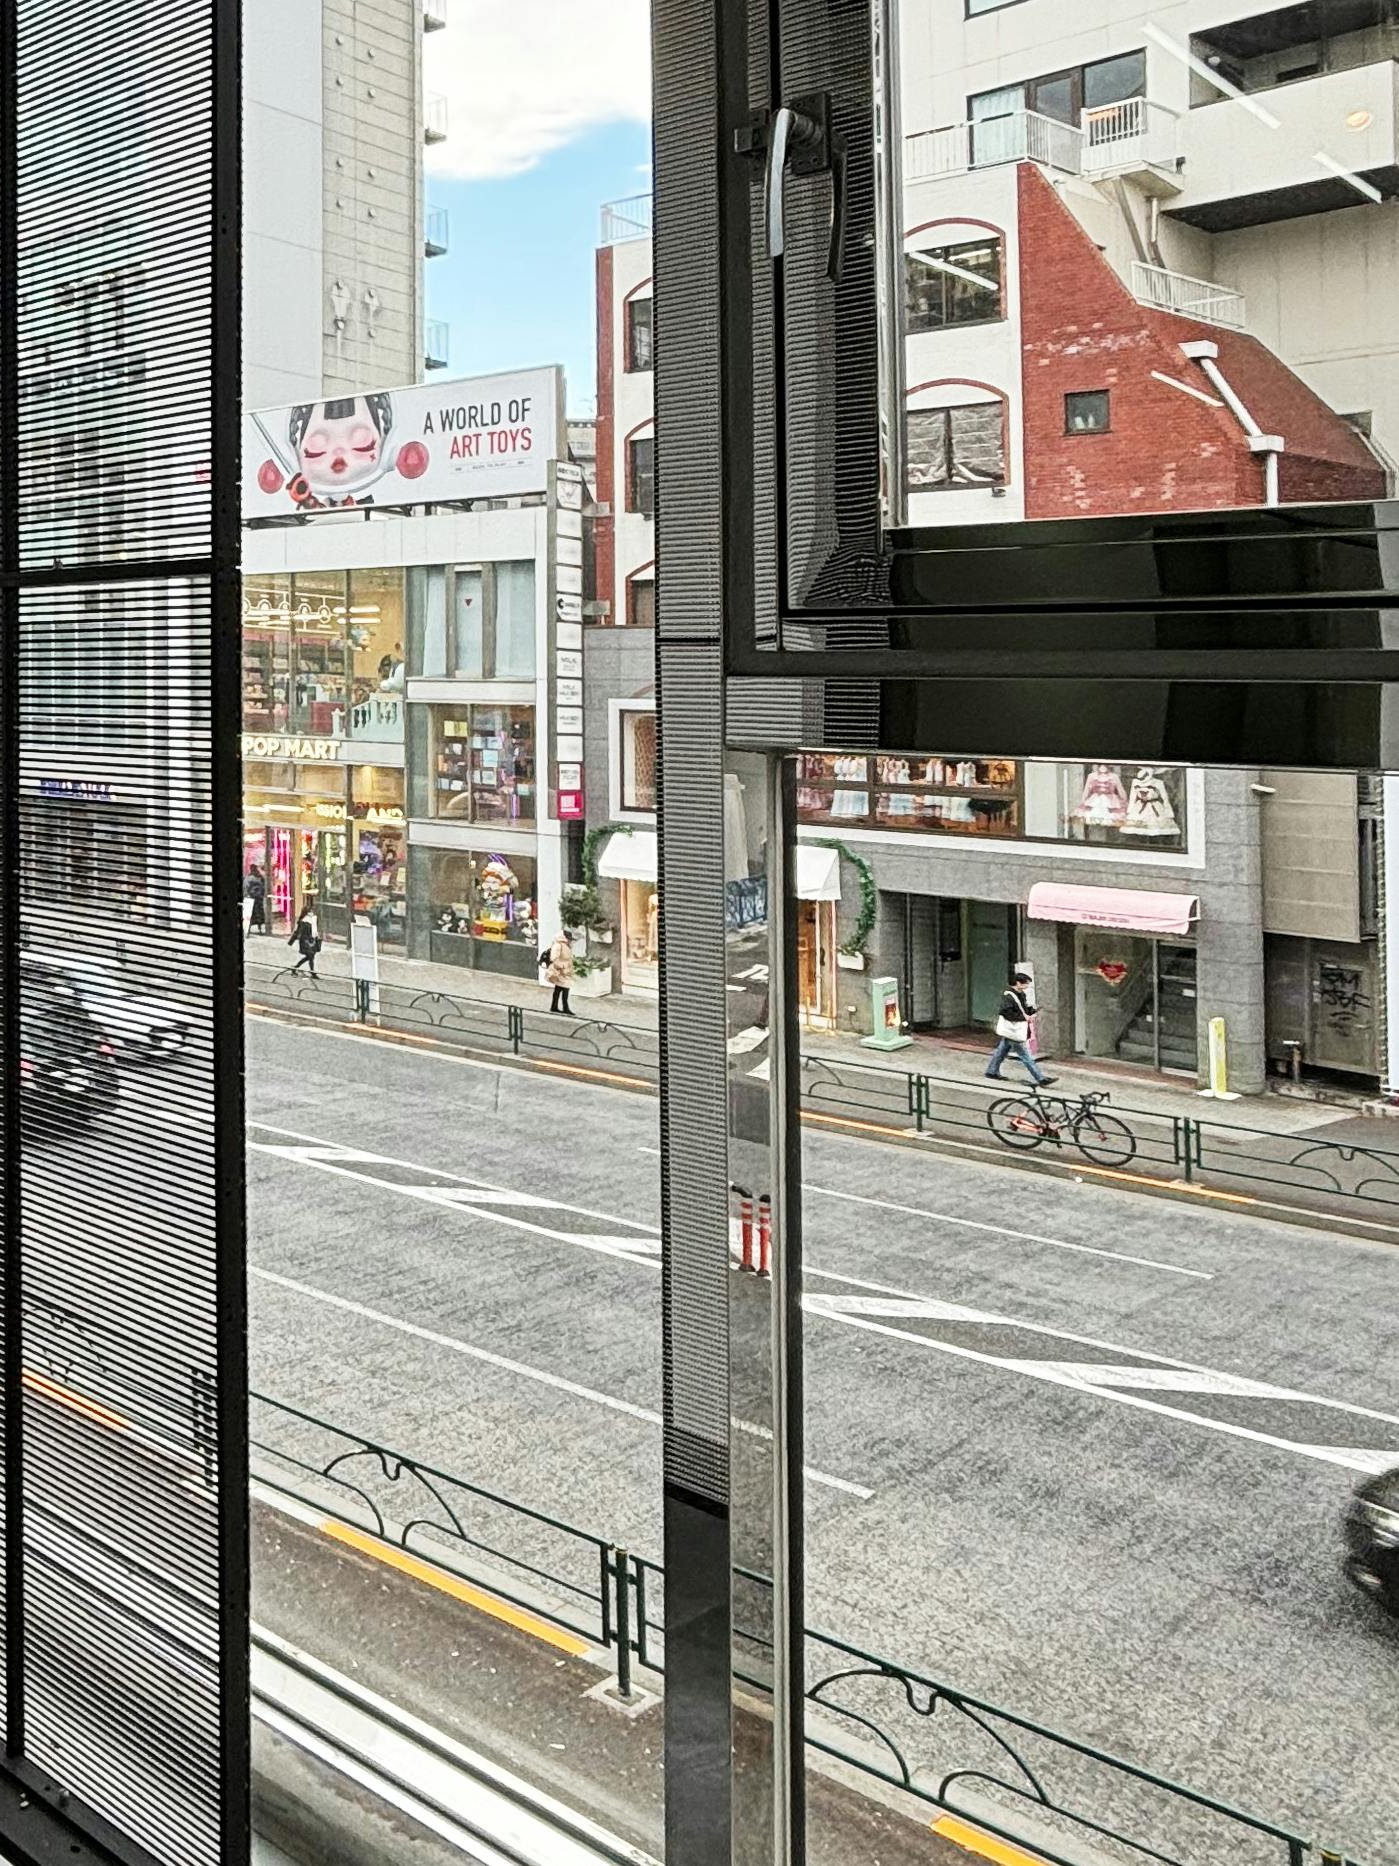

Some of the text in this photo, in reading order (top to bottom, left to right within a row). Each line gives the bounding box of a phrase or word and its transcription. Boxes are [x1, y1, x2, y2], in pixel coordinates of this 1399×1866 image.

[423, 397, 532, 435] A WORLD OF
[449, 426, 532, 460] ART TOYS
[241, 736, 341, 760] POP MART
